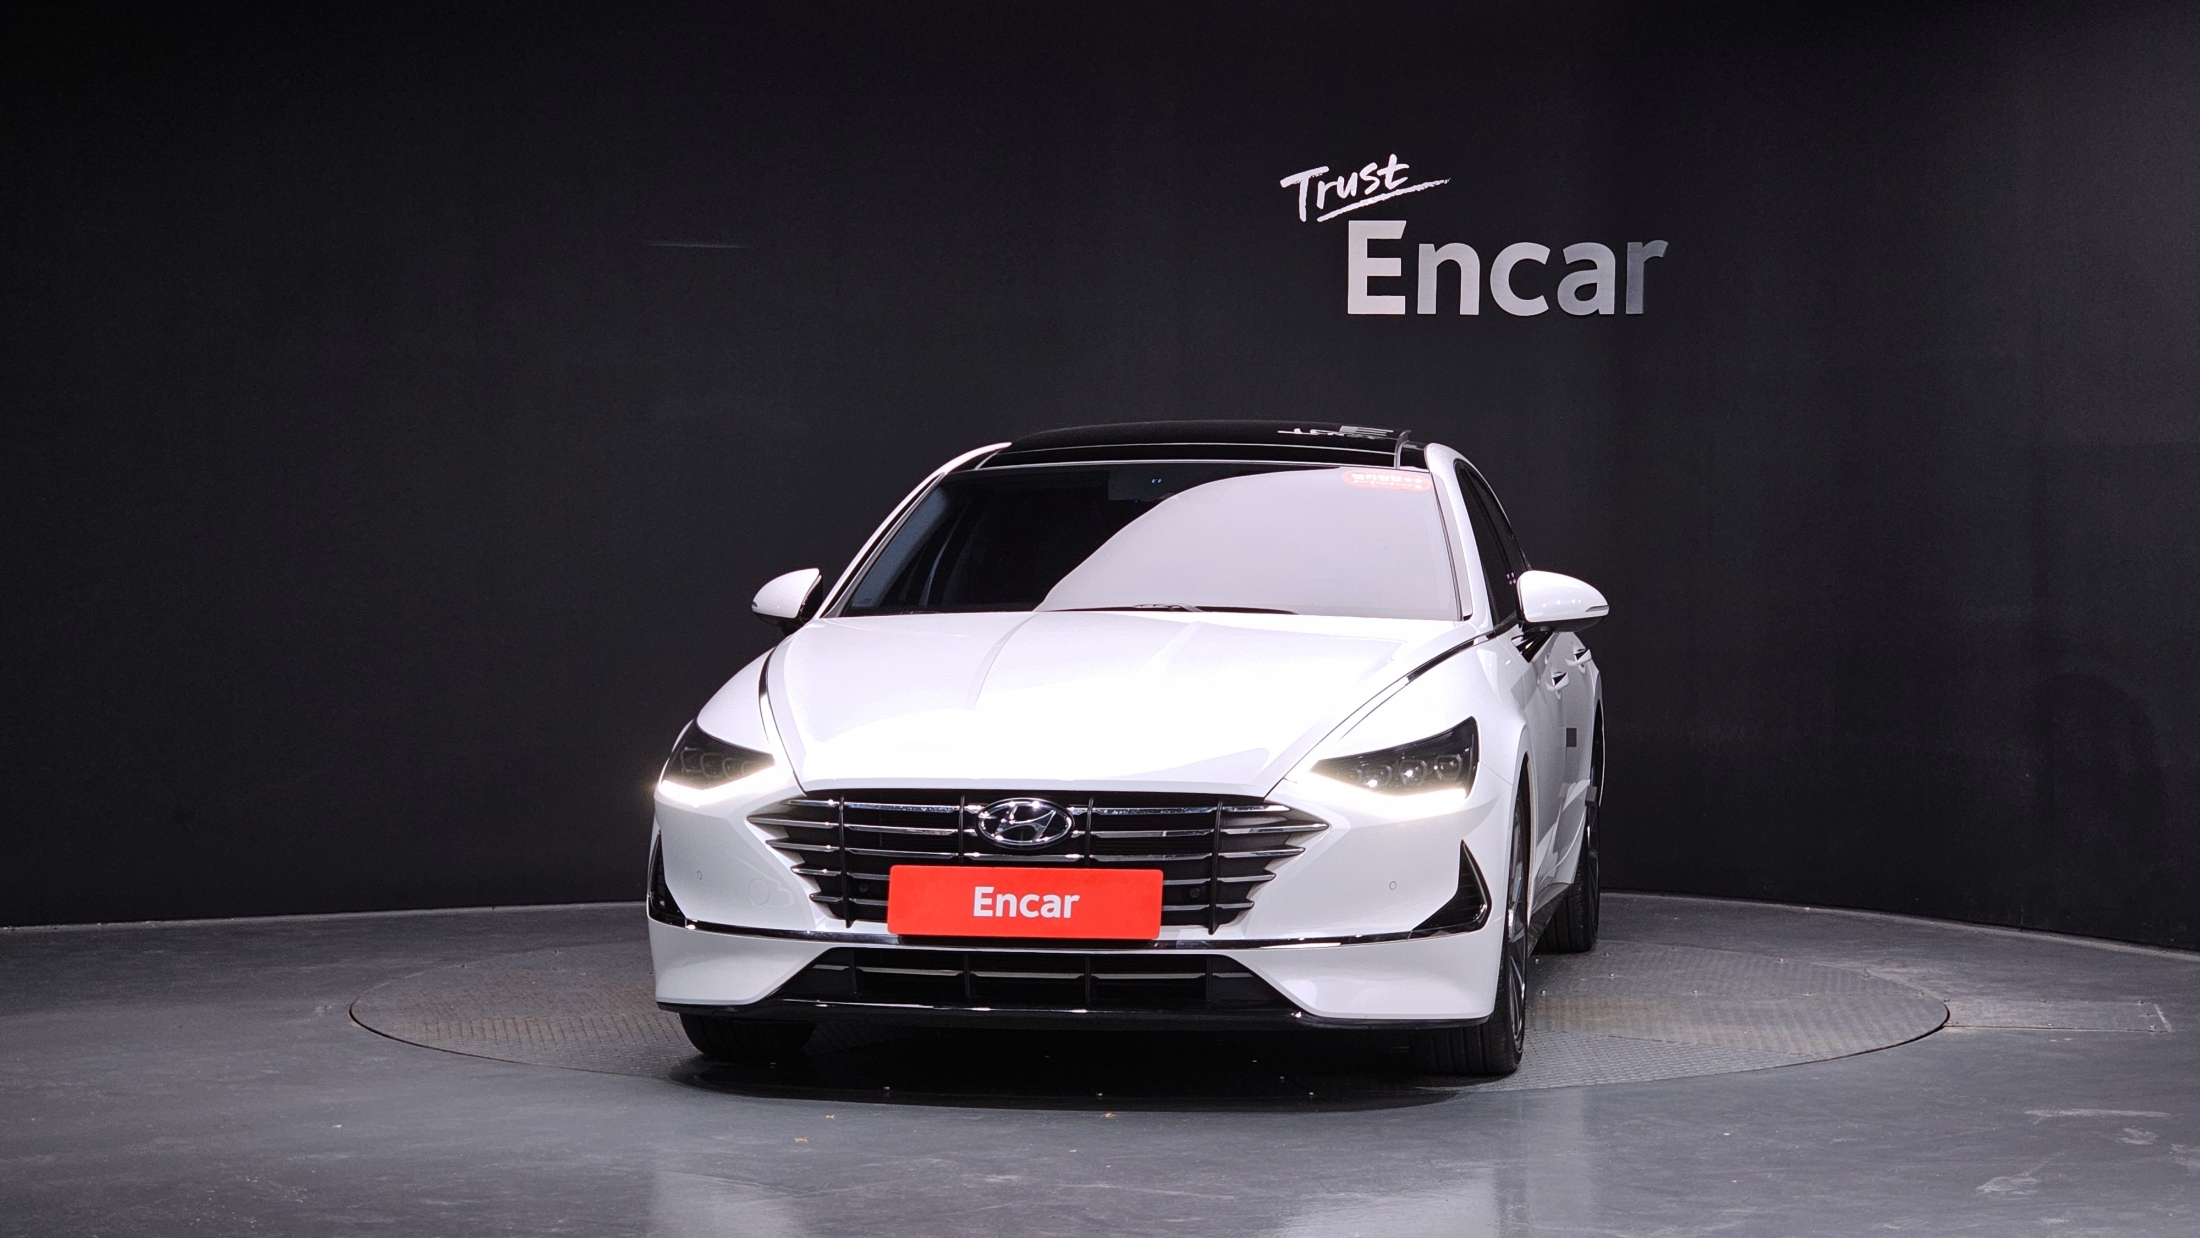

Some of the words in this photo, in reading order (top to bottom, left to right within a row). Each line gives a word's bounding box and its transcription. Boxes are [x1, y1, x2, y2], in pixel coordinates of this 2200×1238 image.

[1279, 153, 1411, 222] Trust
[1347, 219, 1669, 317] Encar
[972, 885, 1081, 919] Encar
